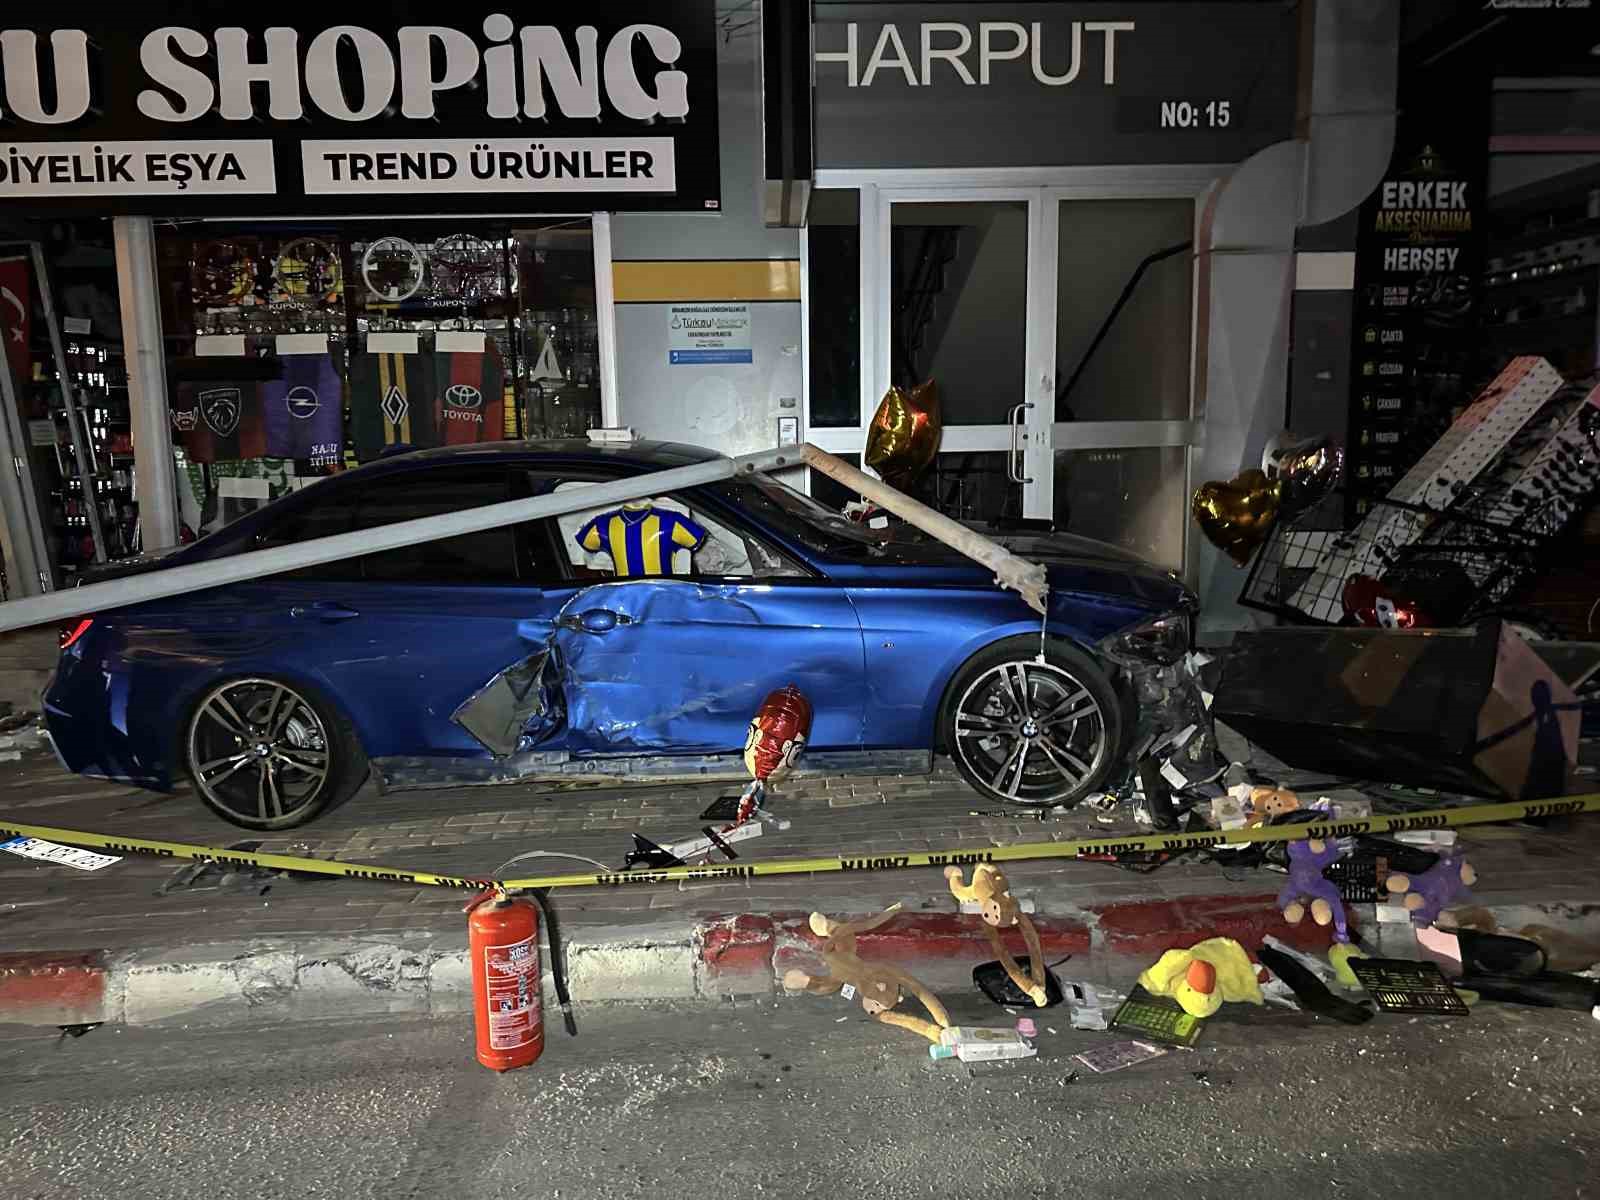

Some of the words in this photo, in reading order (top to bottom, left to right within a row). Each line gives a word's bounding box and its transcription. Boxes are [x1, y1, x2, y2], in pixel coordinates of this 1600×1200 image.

[812, 23, 1134, 87] HARPUT
[0, 30, 90, 123] U
[1161, 102, 1198, 127] NO:
[1206, 102, 1230, 127] 15
[146, 152, 245, 189] EŞYA
[324, 153, 457, 180] TREND
[470, 144, 654, 180] ÜRÜNLER
[1382, 181, 1468, 208] ERKEK
[443, 409, 483, 422] TOYOTA
